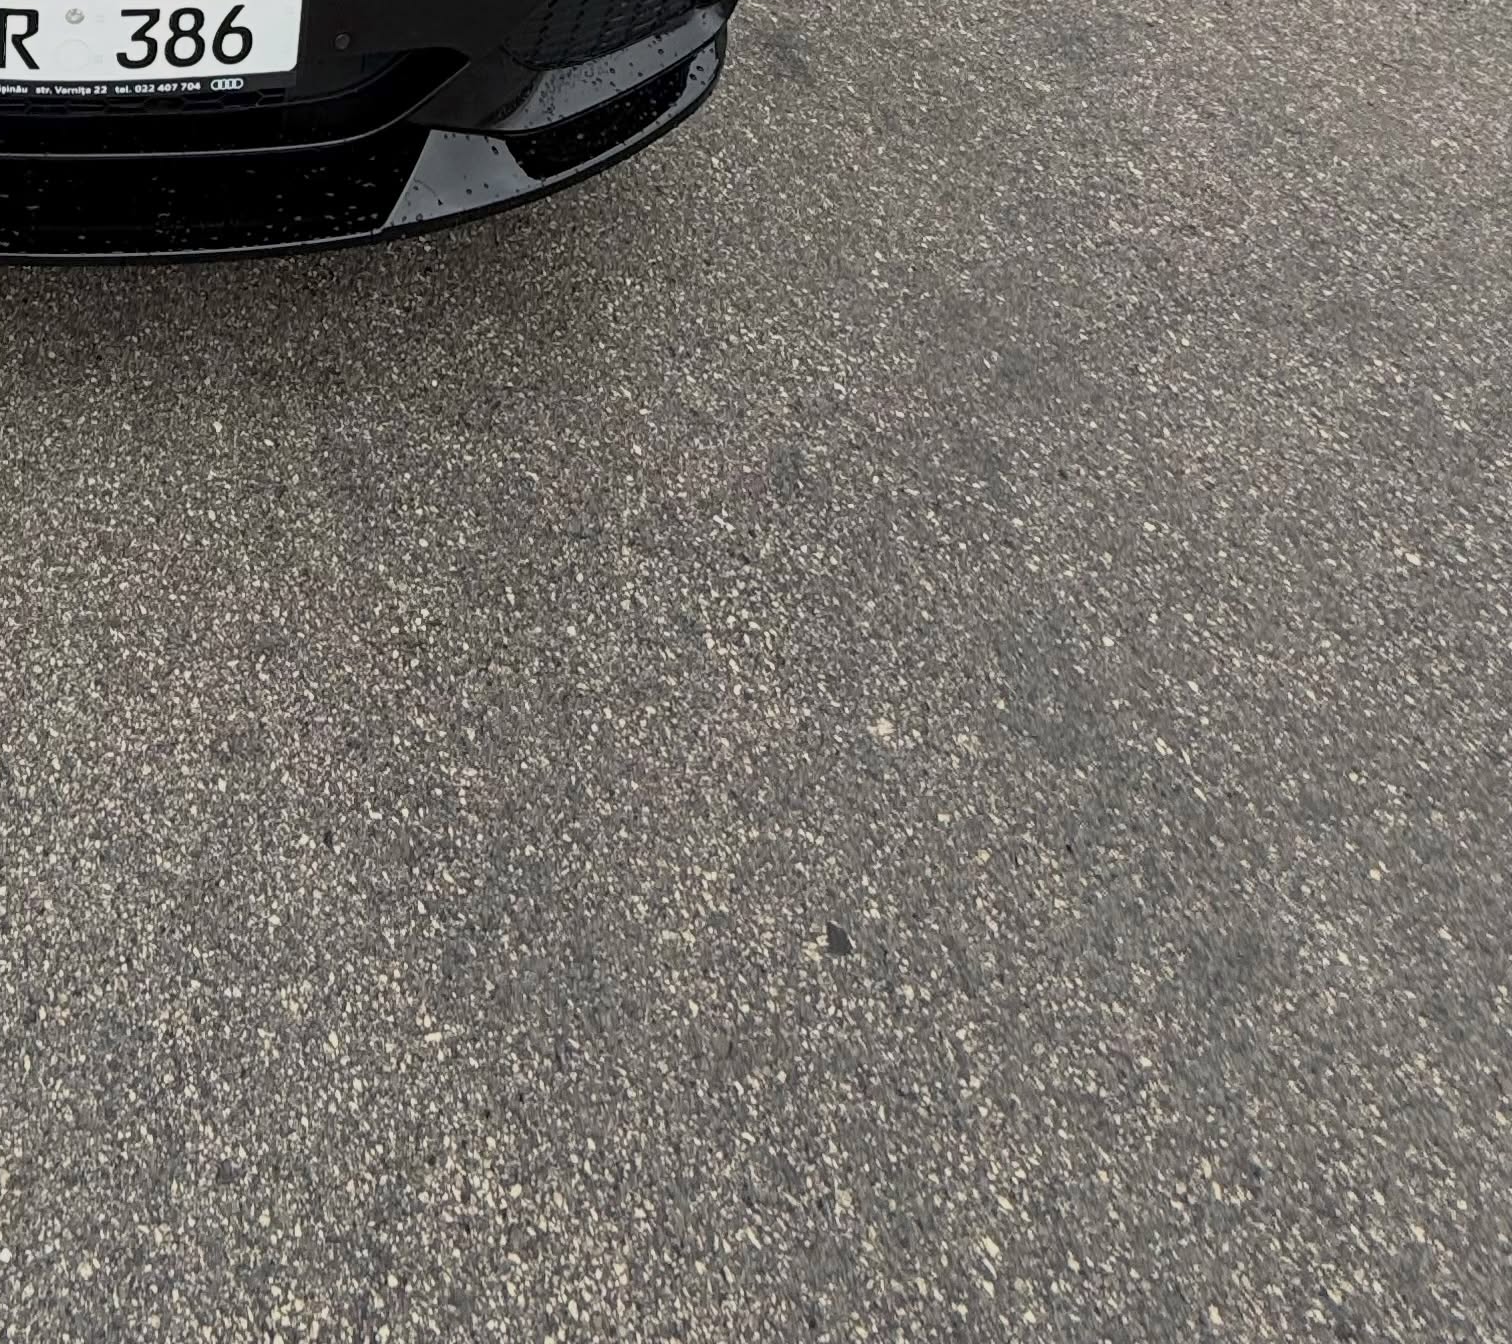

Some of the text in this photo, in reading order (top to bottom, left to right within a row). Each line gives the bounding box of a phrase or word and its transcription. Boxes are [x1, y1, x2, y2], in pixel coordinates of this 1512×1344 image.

[116, 3, 254, 70] 386
[93, 85, 108, 95] 22
[114, 85, 133, 94] tel.
[134, 84, 155, 94] 022
[157, 83, 178, 92] 407
[180, 81, 201, 91] 704
